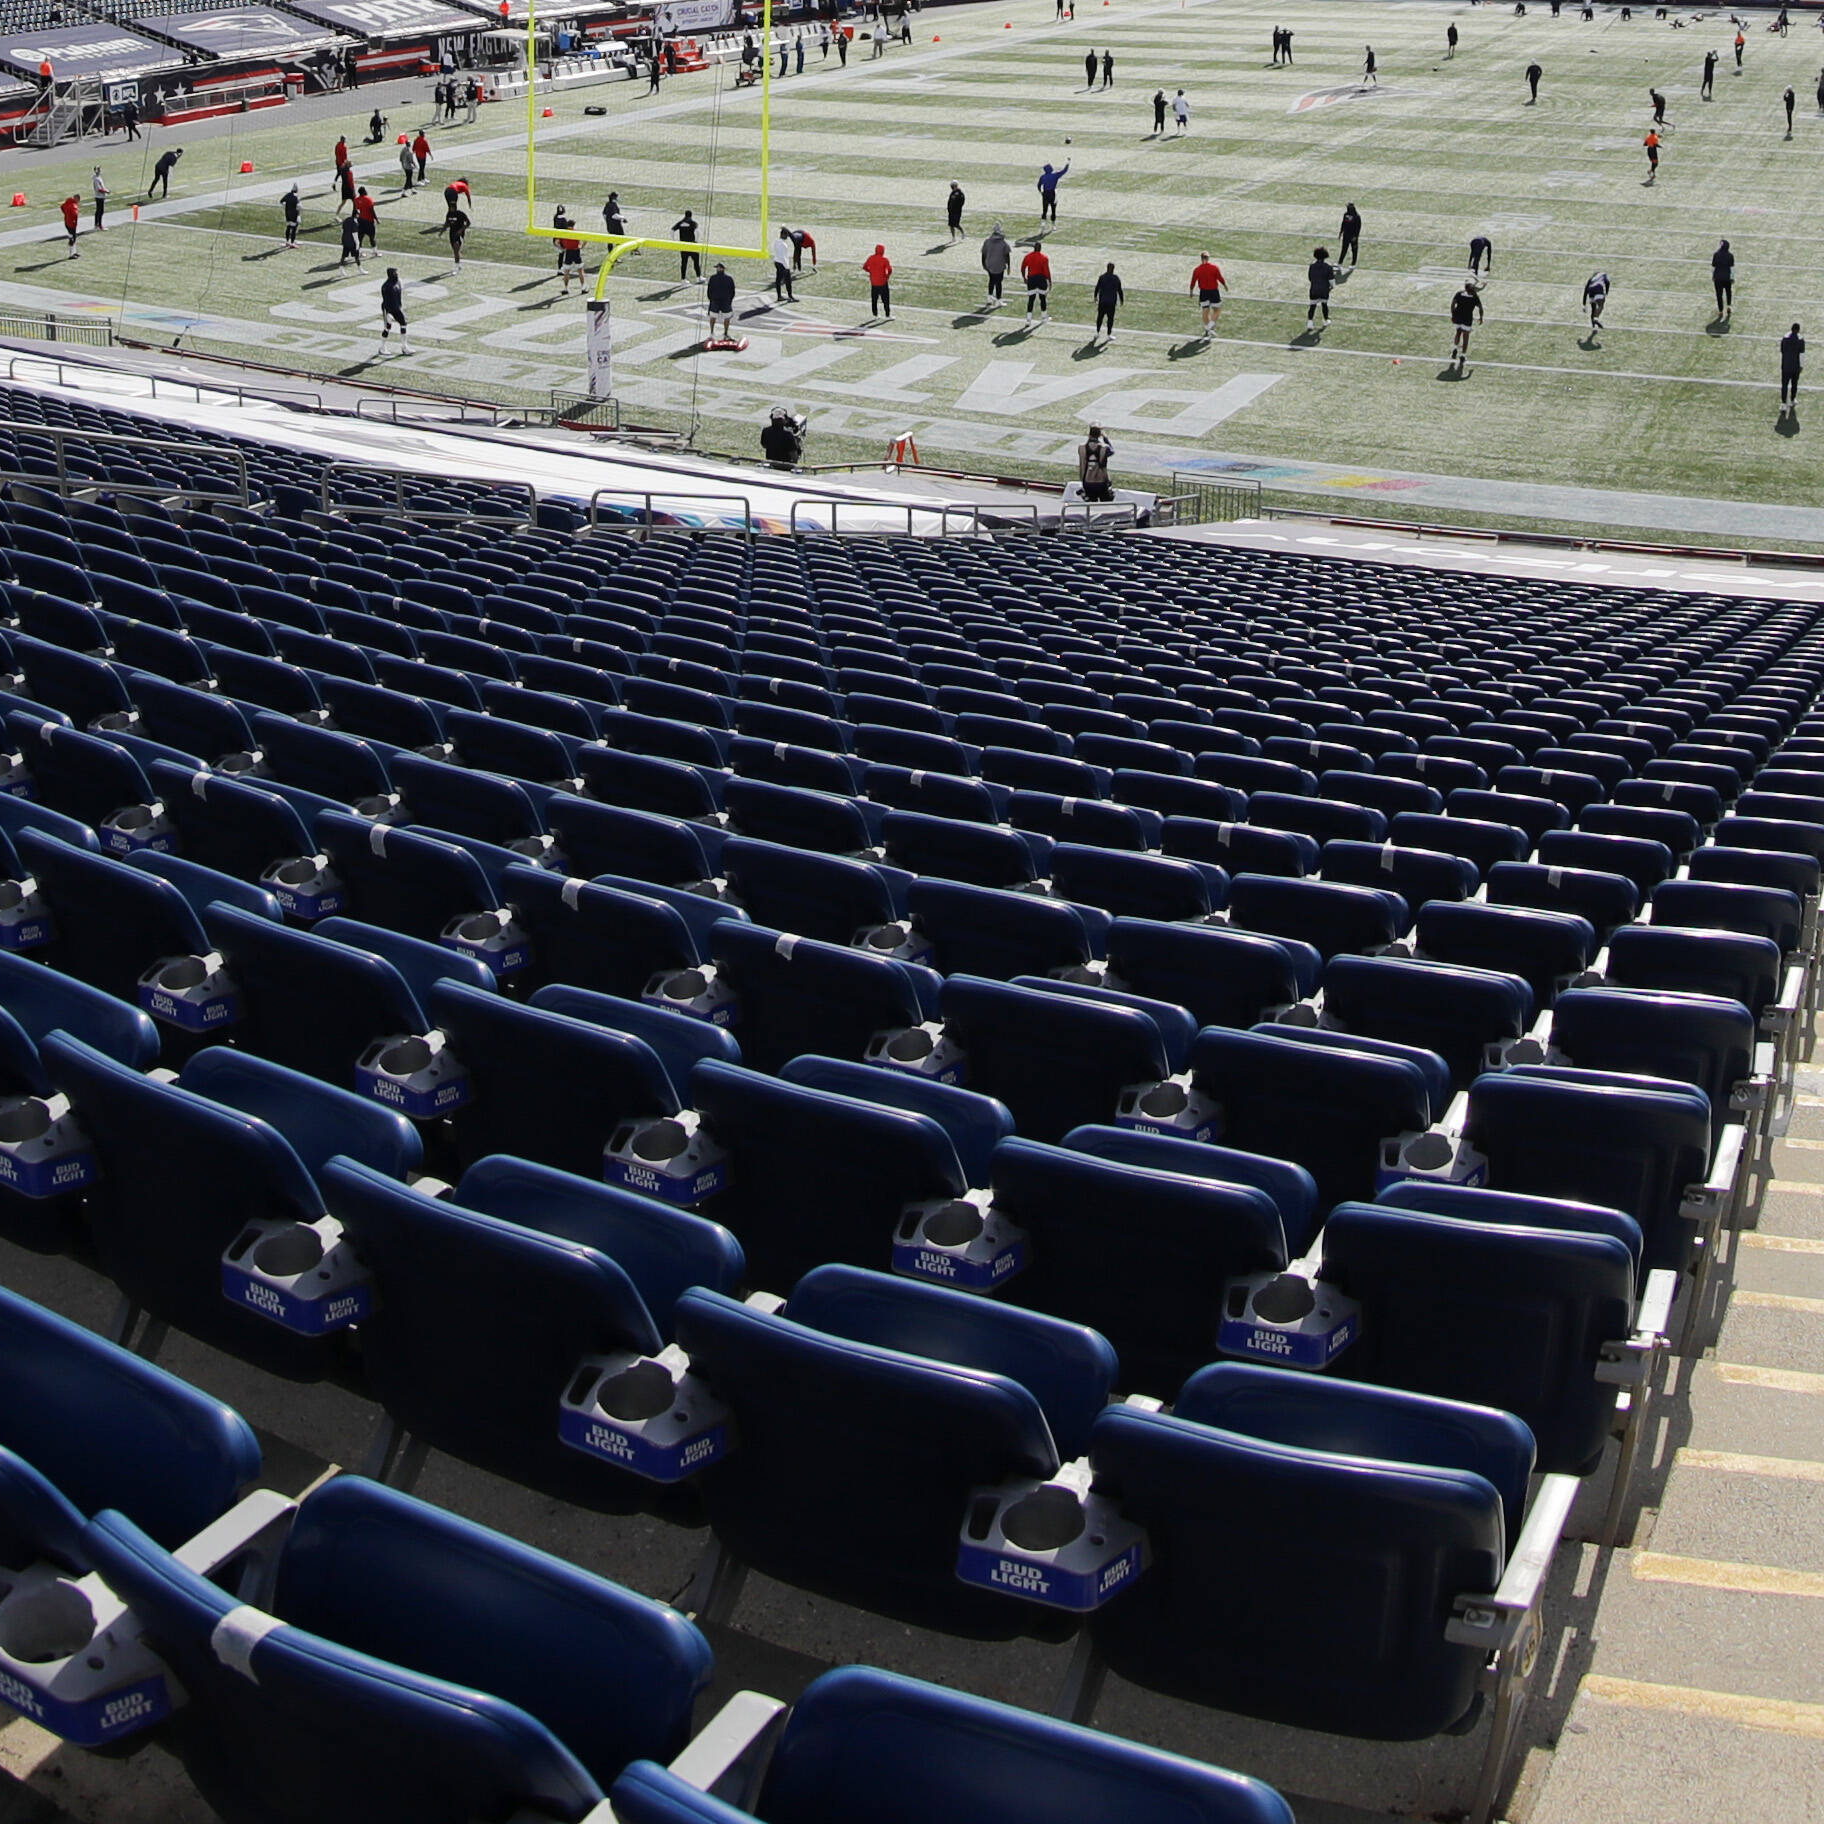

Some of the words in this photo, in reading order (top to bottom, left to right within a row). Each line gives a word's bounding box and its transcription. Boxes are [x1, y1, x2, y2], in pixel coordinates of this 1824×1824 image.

[37, 36, 146, 61] Putnam
[437, 36, 466, 59] NEW
[374, 1086, 406, 1105] LIGHT
[376, 1078, 401, 1096] BUD
[52, 1169, 86, 1185] LIGHT
[55, 1162, 80, 1177] BUD
[628, 1165, 656, 1182] BUD
[623, 1175, 661, 1193] LIGHT
[919, 1250, 951, 1267] BUD
[914, 1259, 957, 1278] LIGHT
[249, 1282, 280, 1304] BUD
[244, 1292, 287, 1318] LIGHT
[324, 1303, 360, 1322] LIGHT
[328, 1296, 355, 1313] BUD
[1246, 1338, 1294, 1356] LIGHT
[1254, 1330, 1288, 1345] BUD
[591, 1423, 629, 1447] BUD
[584, 1433, 636, 1461] LIGHT
[680, 1445, 716, 1468] LIGHT
[686, 1437, 714, 1457] BUD
[999, 1560, 1043, 1579] BUD
[1103, 1559, 1130, 1579] BUD
[990, 1572, 1051, 1594] LIGHT
[1098, 1567, 1132, 1594] LIGHT
[105, 1693, 144, 1715] BUD
[101, 1700, 154, 1729] LIGHT
